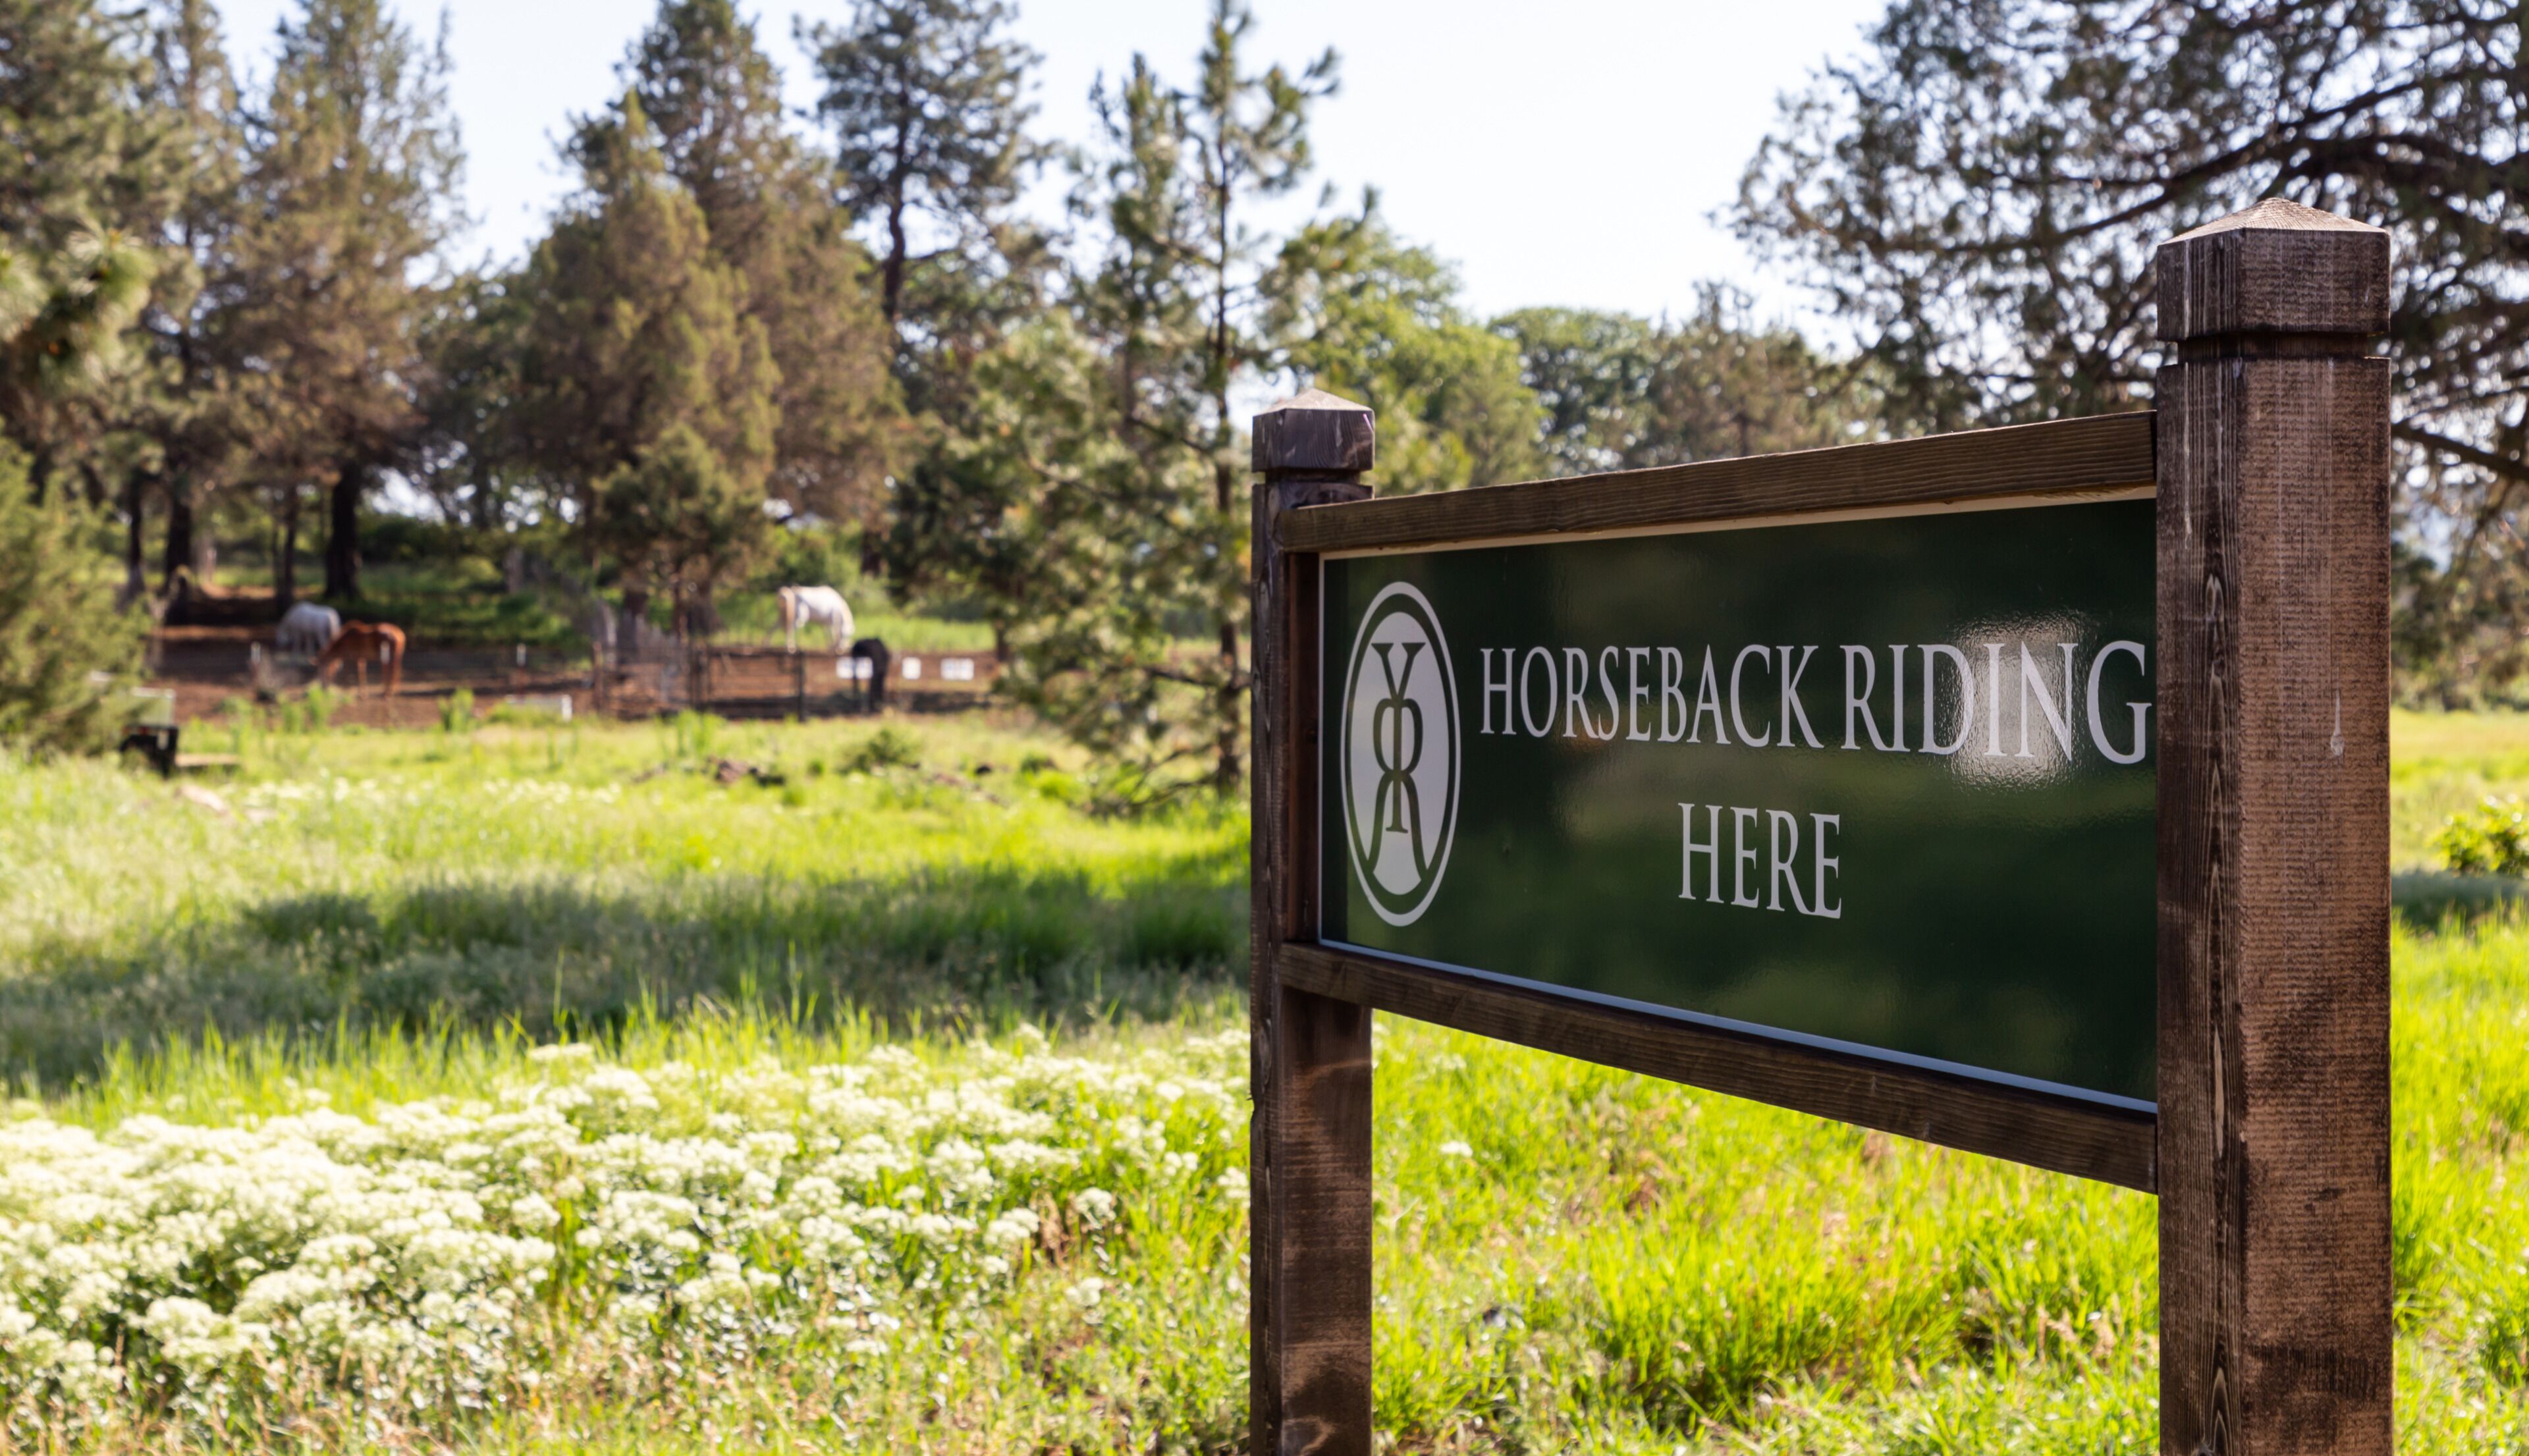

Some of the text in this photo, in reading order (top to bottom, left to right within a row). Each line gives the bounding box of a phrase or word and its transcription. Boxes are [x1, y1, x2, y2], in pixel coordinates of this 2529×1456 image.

[1481, 640, 2152, 765] HORSEBACK RIDING
[1677, 802, 1842, 919] HERE
